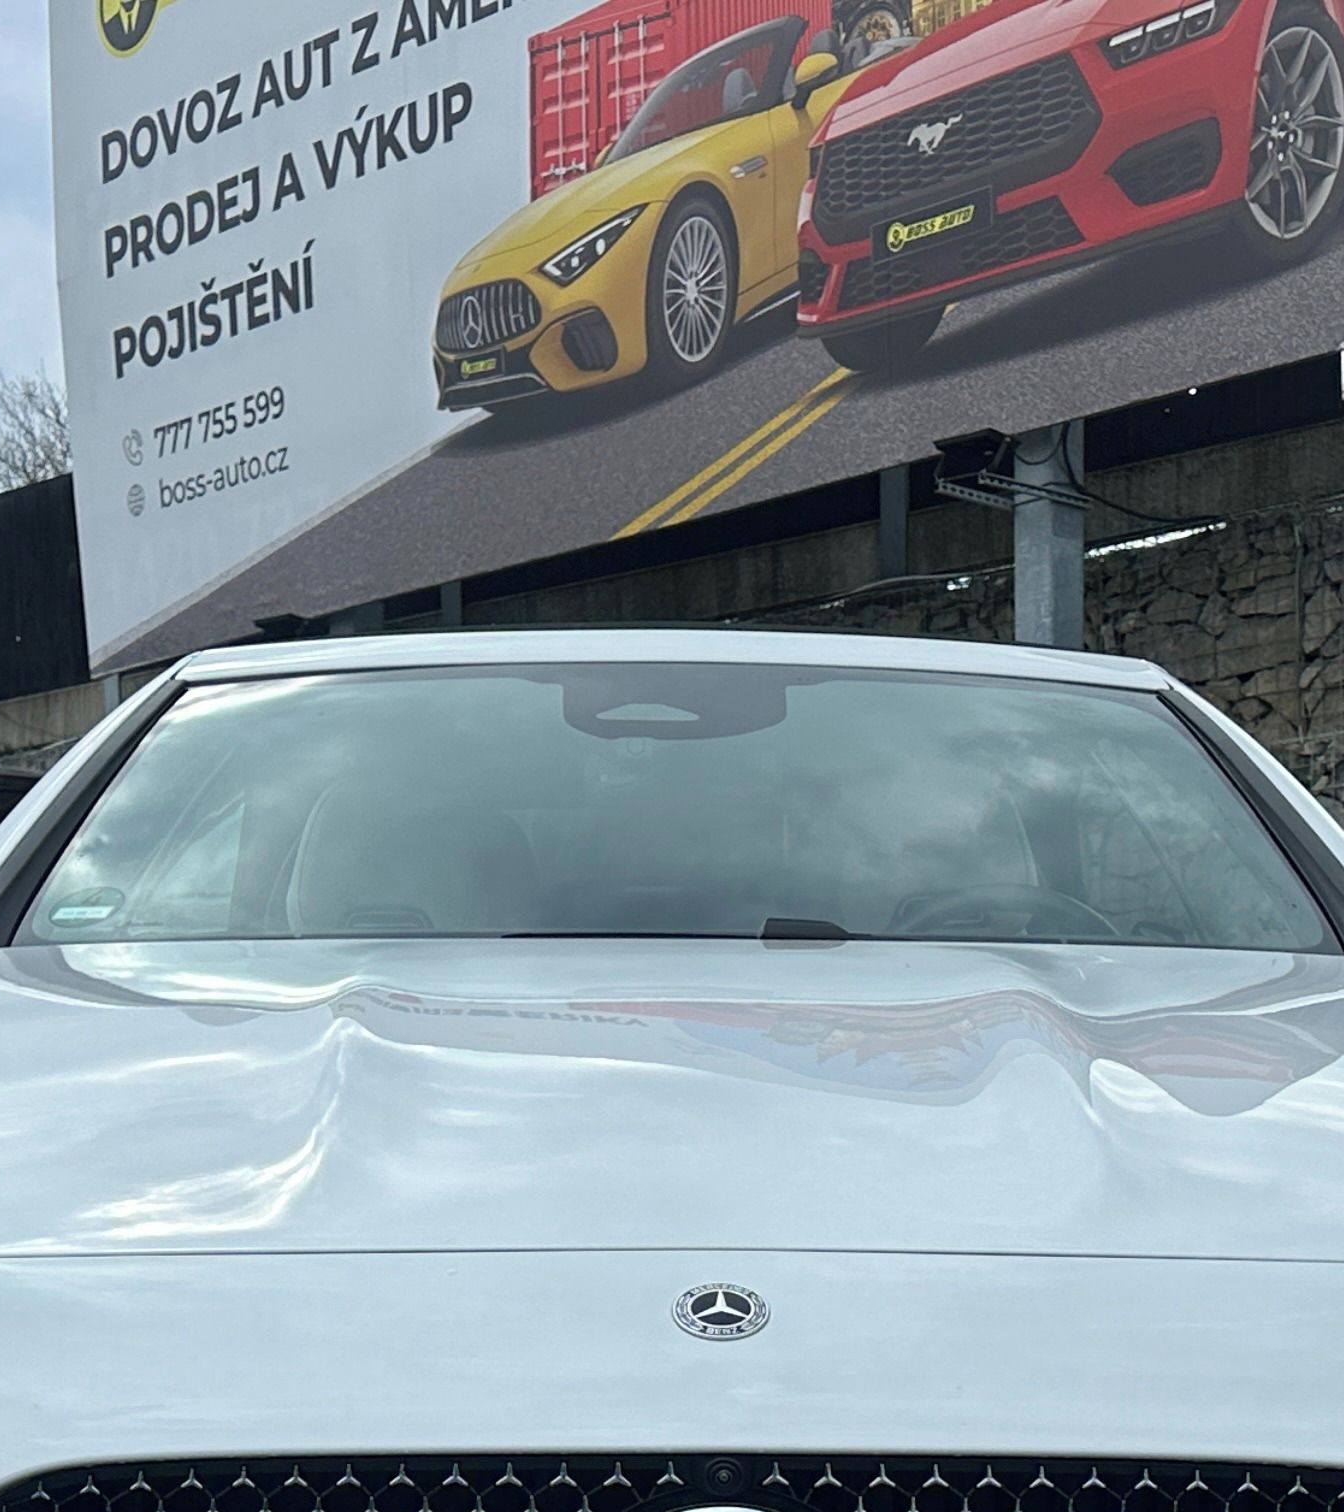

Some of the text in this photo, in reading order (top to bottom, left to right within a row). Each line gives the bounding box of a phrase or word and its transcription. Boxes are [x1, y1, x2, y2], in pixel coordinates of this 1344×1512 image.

[102, 73, 243, 184] DOVOZ
[252, 29, 340, 118] AUT
[351, 12, 380, 75] Z
[105, 81, 473, 278] PRODEJ A VÝKUP
[113, 239, 316, 378] POJIŠTĚNÍ
[154, 386, 285, 458] 777 755 599
[159, 446, 290, 508] boss-auto.cz
